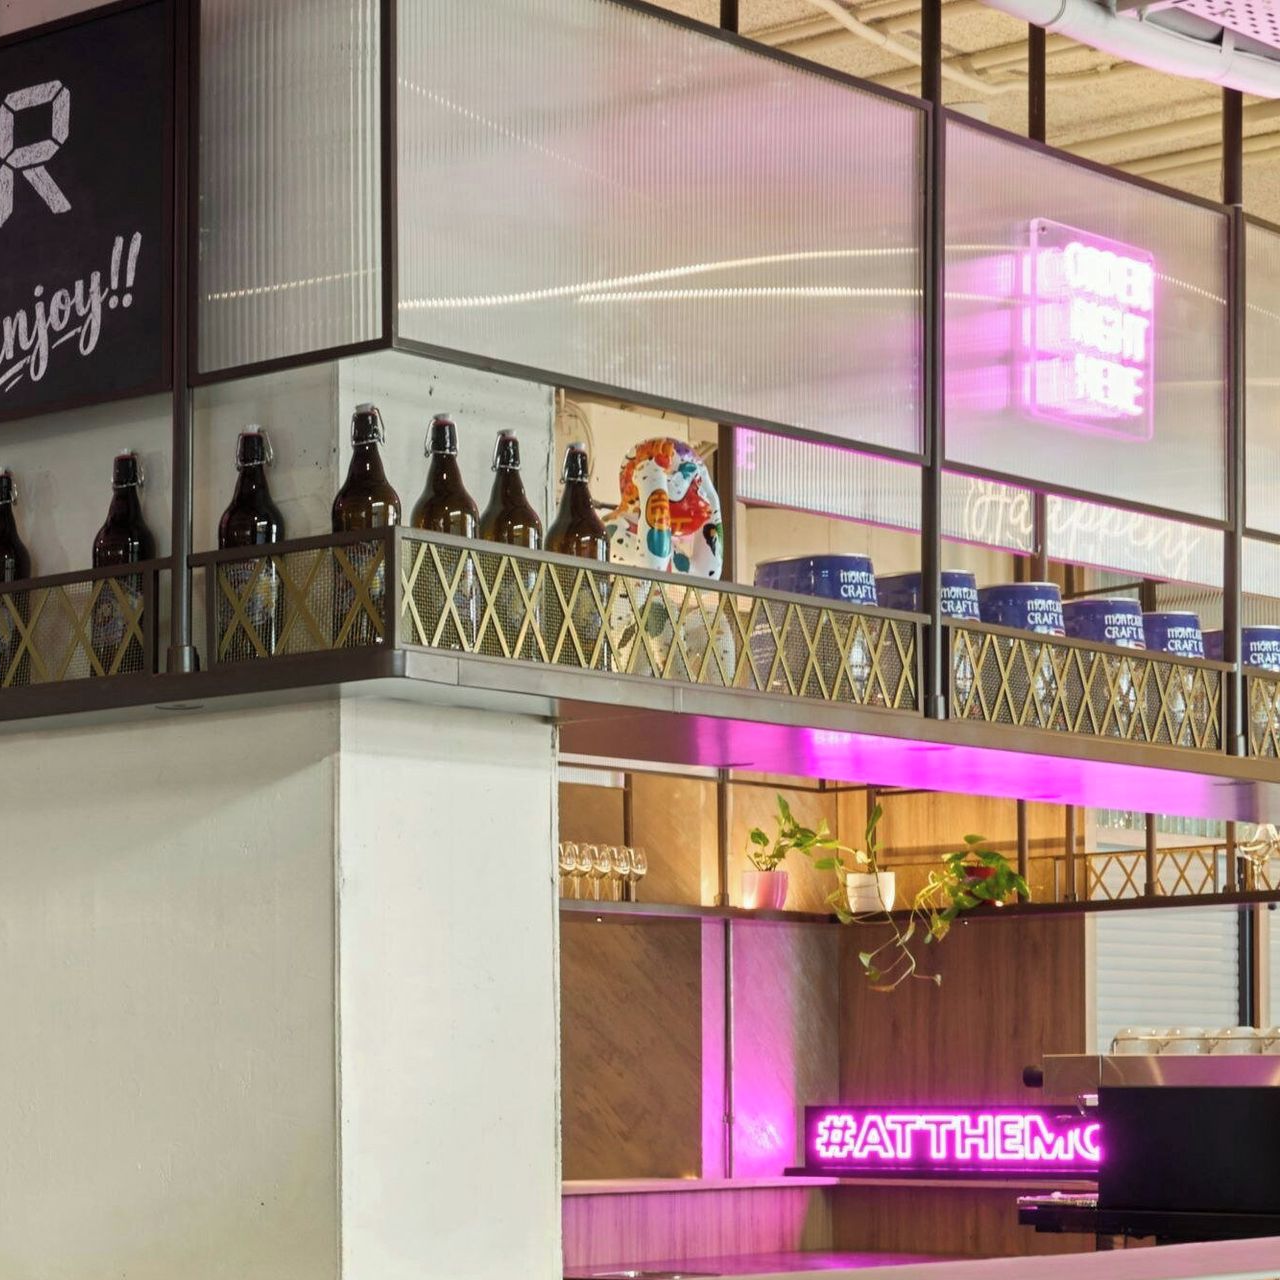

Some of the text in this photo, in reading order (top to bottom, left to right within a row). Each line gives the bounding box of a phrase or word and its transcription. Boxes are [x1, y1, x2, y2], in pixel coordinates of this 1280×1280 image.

[840, 584, 872, 599] CRAFT
[941, 600, 974, 614] CRAFT
[1027, 612, 1059, 626] CRAFT
[1104, 626, 1138, 640] CRAFT
[1167, 639, 1198, 653] CRAFT
